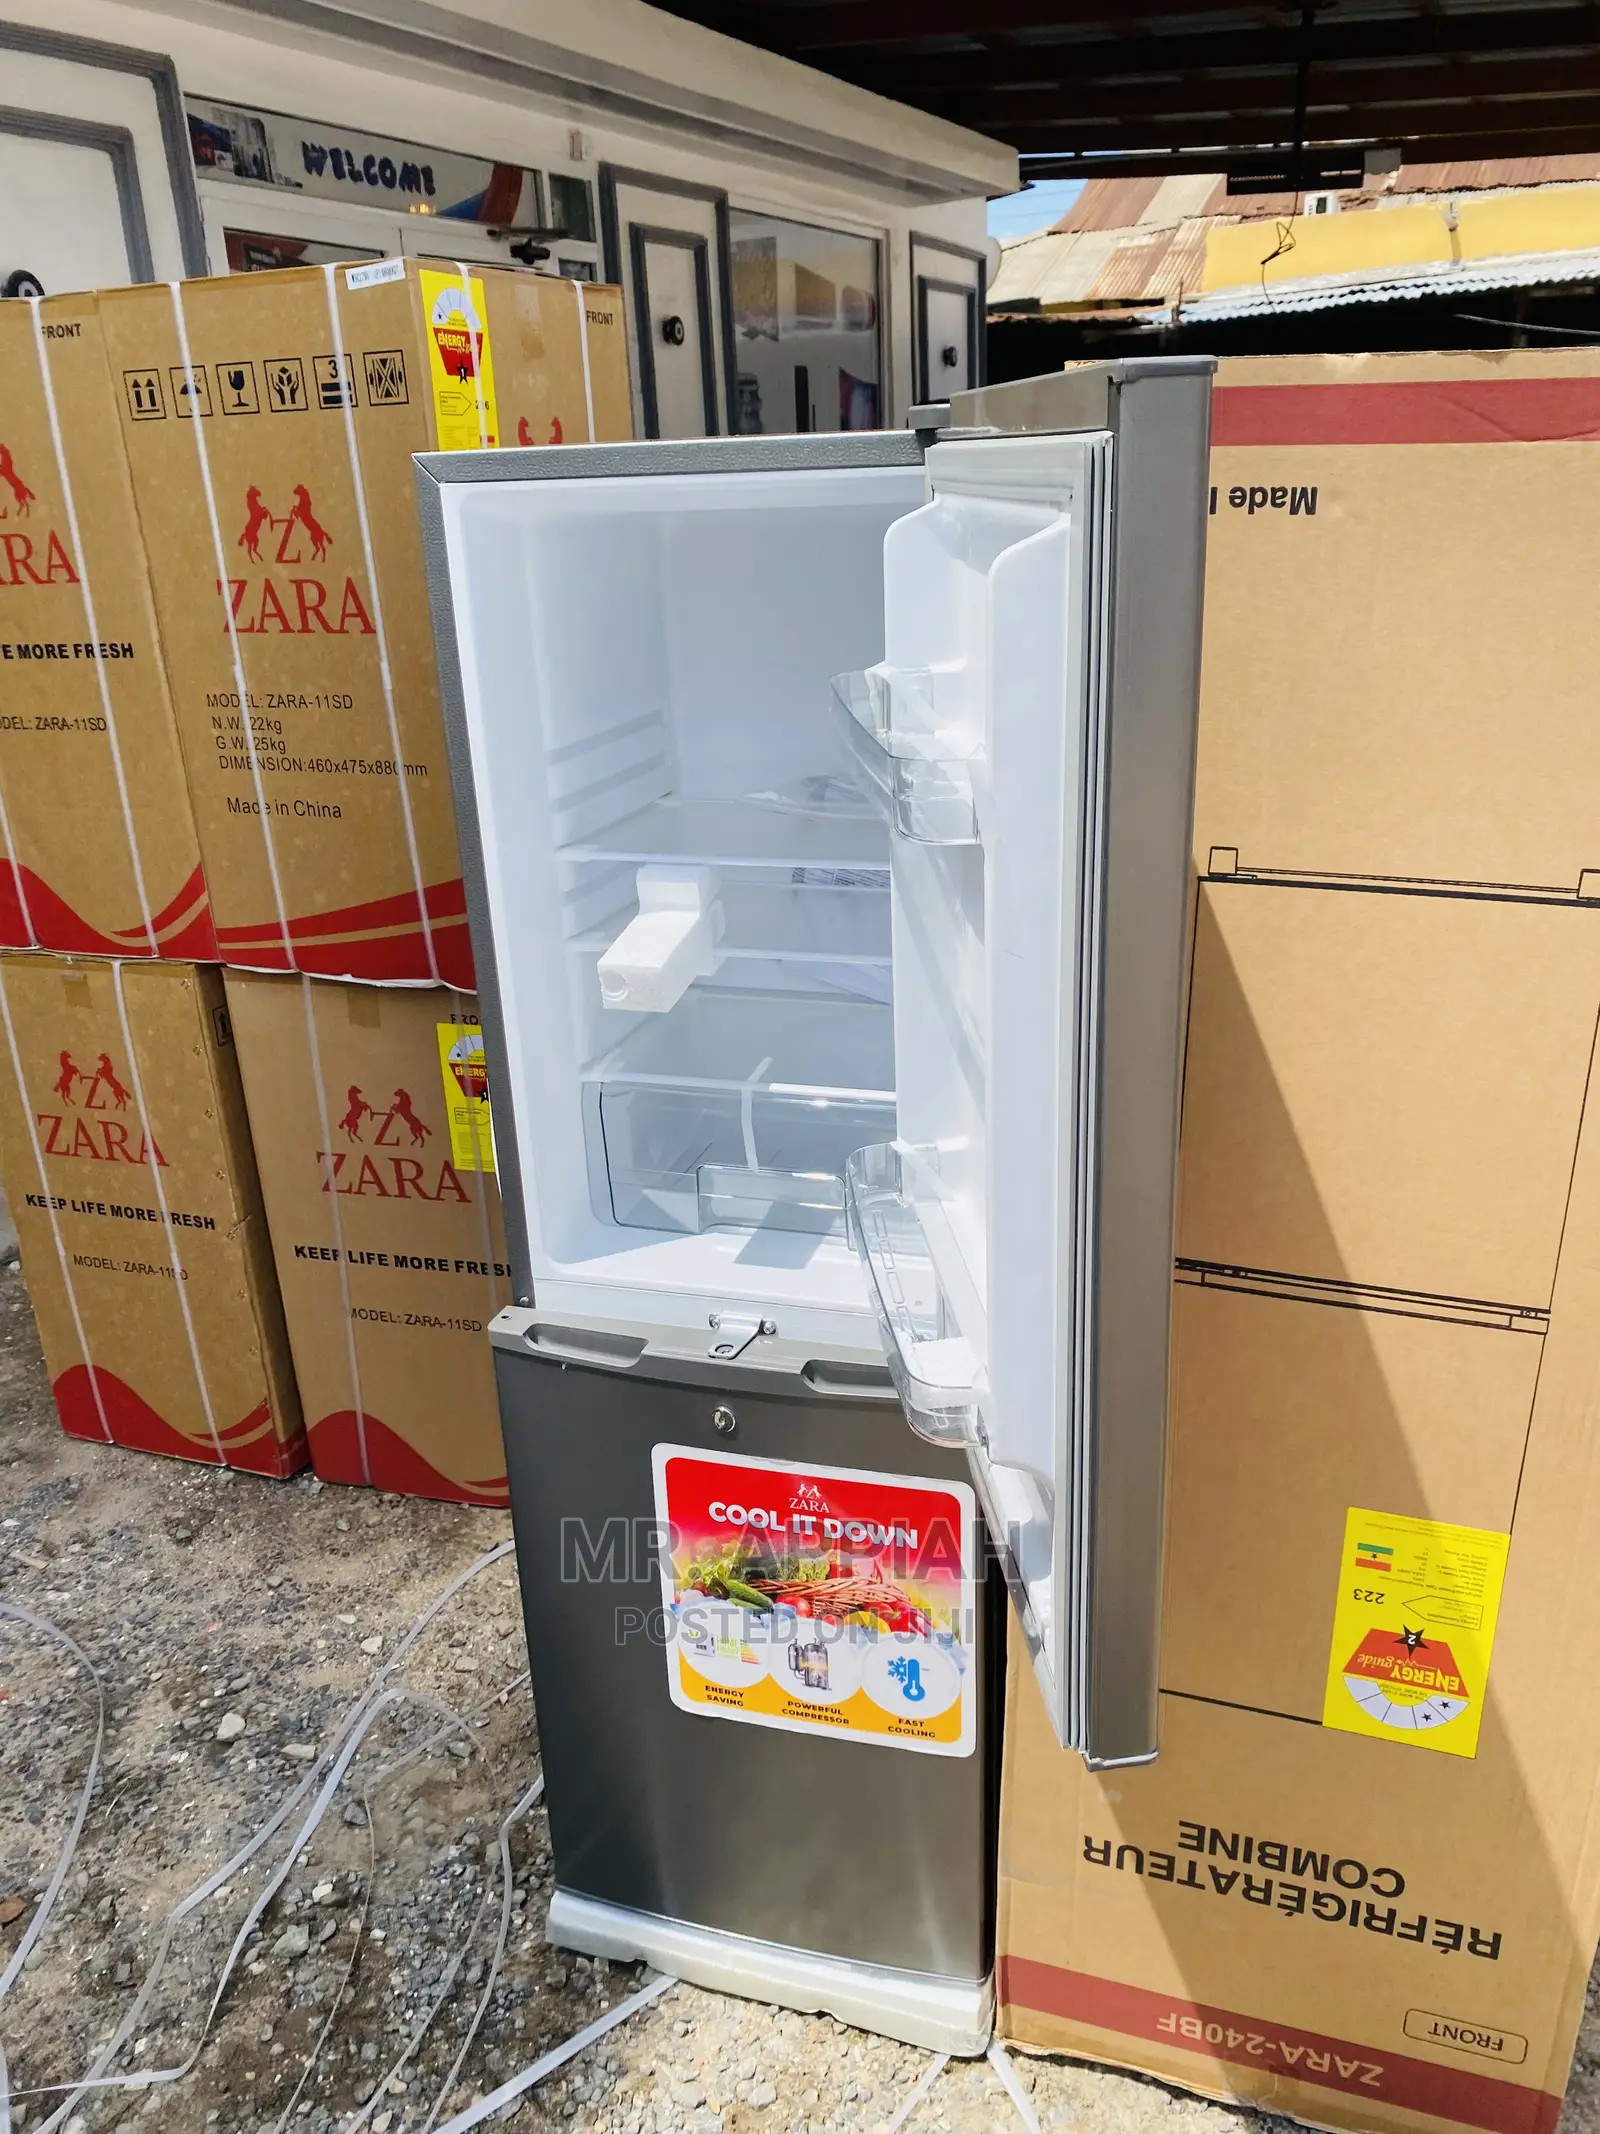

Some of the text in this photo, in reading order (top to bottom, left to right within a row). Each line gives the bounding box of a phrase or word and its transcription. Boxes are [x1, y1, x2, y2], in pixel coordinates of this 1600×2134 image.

[301, 139, 436, 196] WELCOME
[586, 309, 614, 326] FRONT
[437, 330, 466, 347] ENERGY
[1228, 486, 1318, 516] Made
[216, 575, 378, 635] ZARA
[17, 643, 70, 660] MORE
[74, 642, 134, 659] FRESH
[267, 693, 354, 710] ZARA-11SD
[0, 716, 107, 732] DEL: ZARA-11SD
[250, 716, 282, 735] 22kg
[254, 736, 287, 755] 25kg
[227, 796, 342, 819] Made in China
[37, 1113, 170, 1168] ZARA
[315, 1151, 473, 1204] ZARA
[26, 1193, 67, 1211] KEEP
[71, 1200, 107, 1216] LIFE
[110, 1205, 157, 1223] MORE
[73, 1254, 121, 1272] MODEL:
[347, 1250, 390, 1267] LIFE
[393, 1255, 450, 1273] MORE
[403, 1313, 483, 1333] ZARA-11SD
[789, 1497, 831, 1514] ZARA
[708, 1501, 918, 1549] COOL IT DOWN
[1353, 1588, 1386, 1605] 223
[1407, 1634, 1417, 1646] 2
[1357, 1653, 1461, 1694] ENERGY guide
[704, 1685, 745, 1699] ENERGY
[706, 1693, 744, 1708] SAVING
[781, 1708, 850, 1726] COMPRESSOR
[786, 1700, 844, 1717] POWERFUL
[887, 1725, 936, 1739] COOLING
[897, 1718, 926, 1728] FAST
[1177, 1819, 1406, 1899] COMBINE
[1083, 1834, 1503, 1961] RÉFRIGÉRATEUR
[1427, 2020, 1505, 2053] FRONT
[1156, 2011, 1385, 2088] ZARA-240BF
